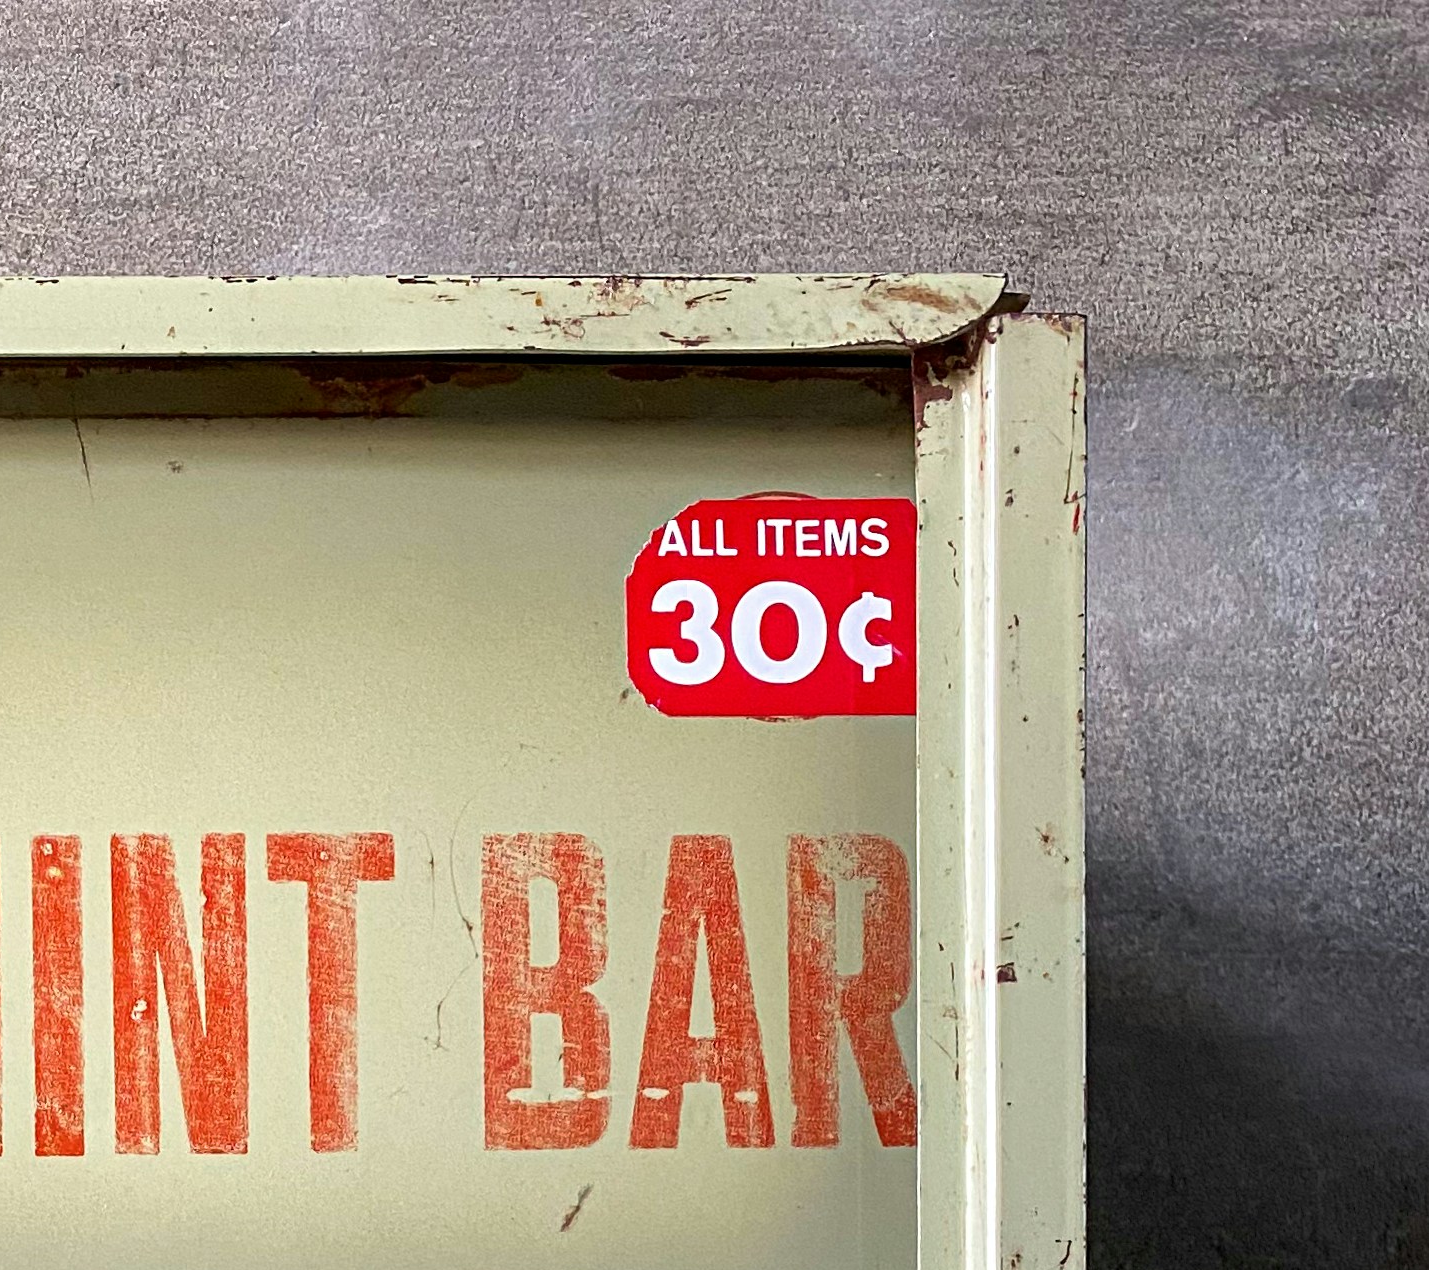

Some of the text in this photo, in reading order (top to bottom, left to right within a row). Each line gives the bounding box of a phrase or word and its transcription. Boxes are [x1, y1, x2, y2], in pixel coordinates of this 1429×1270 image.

[658, 518, 890, 557] ALL ITEMS
[649, 579, 893, 685] 30¢
[480, 831, 917, 1151] BAR
